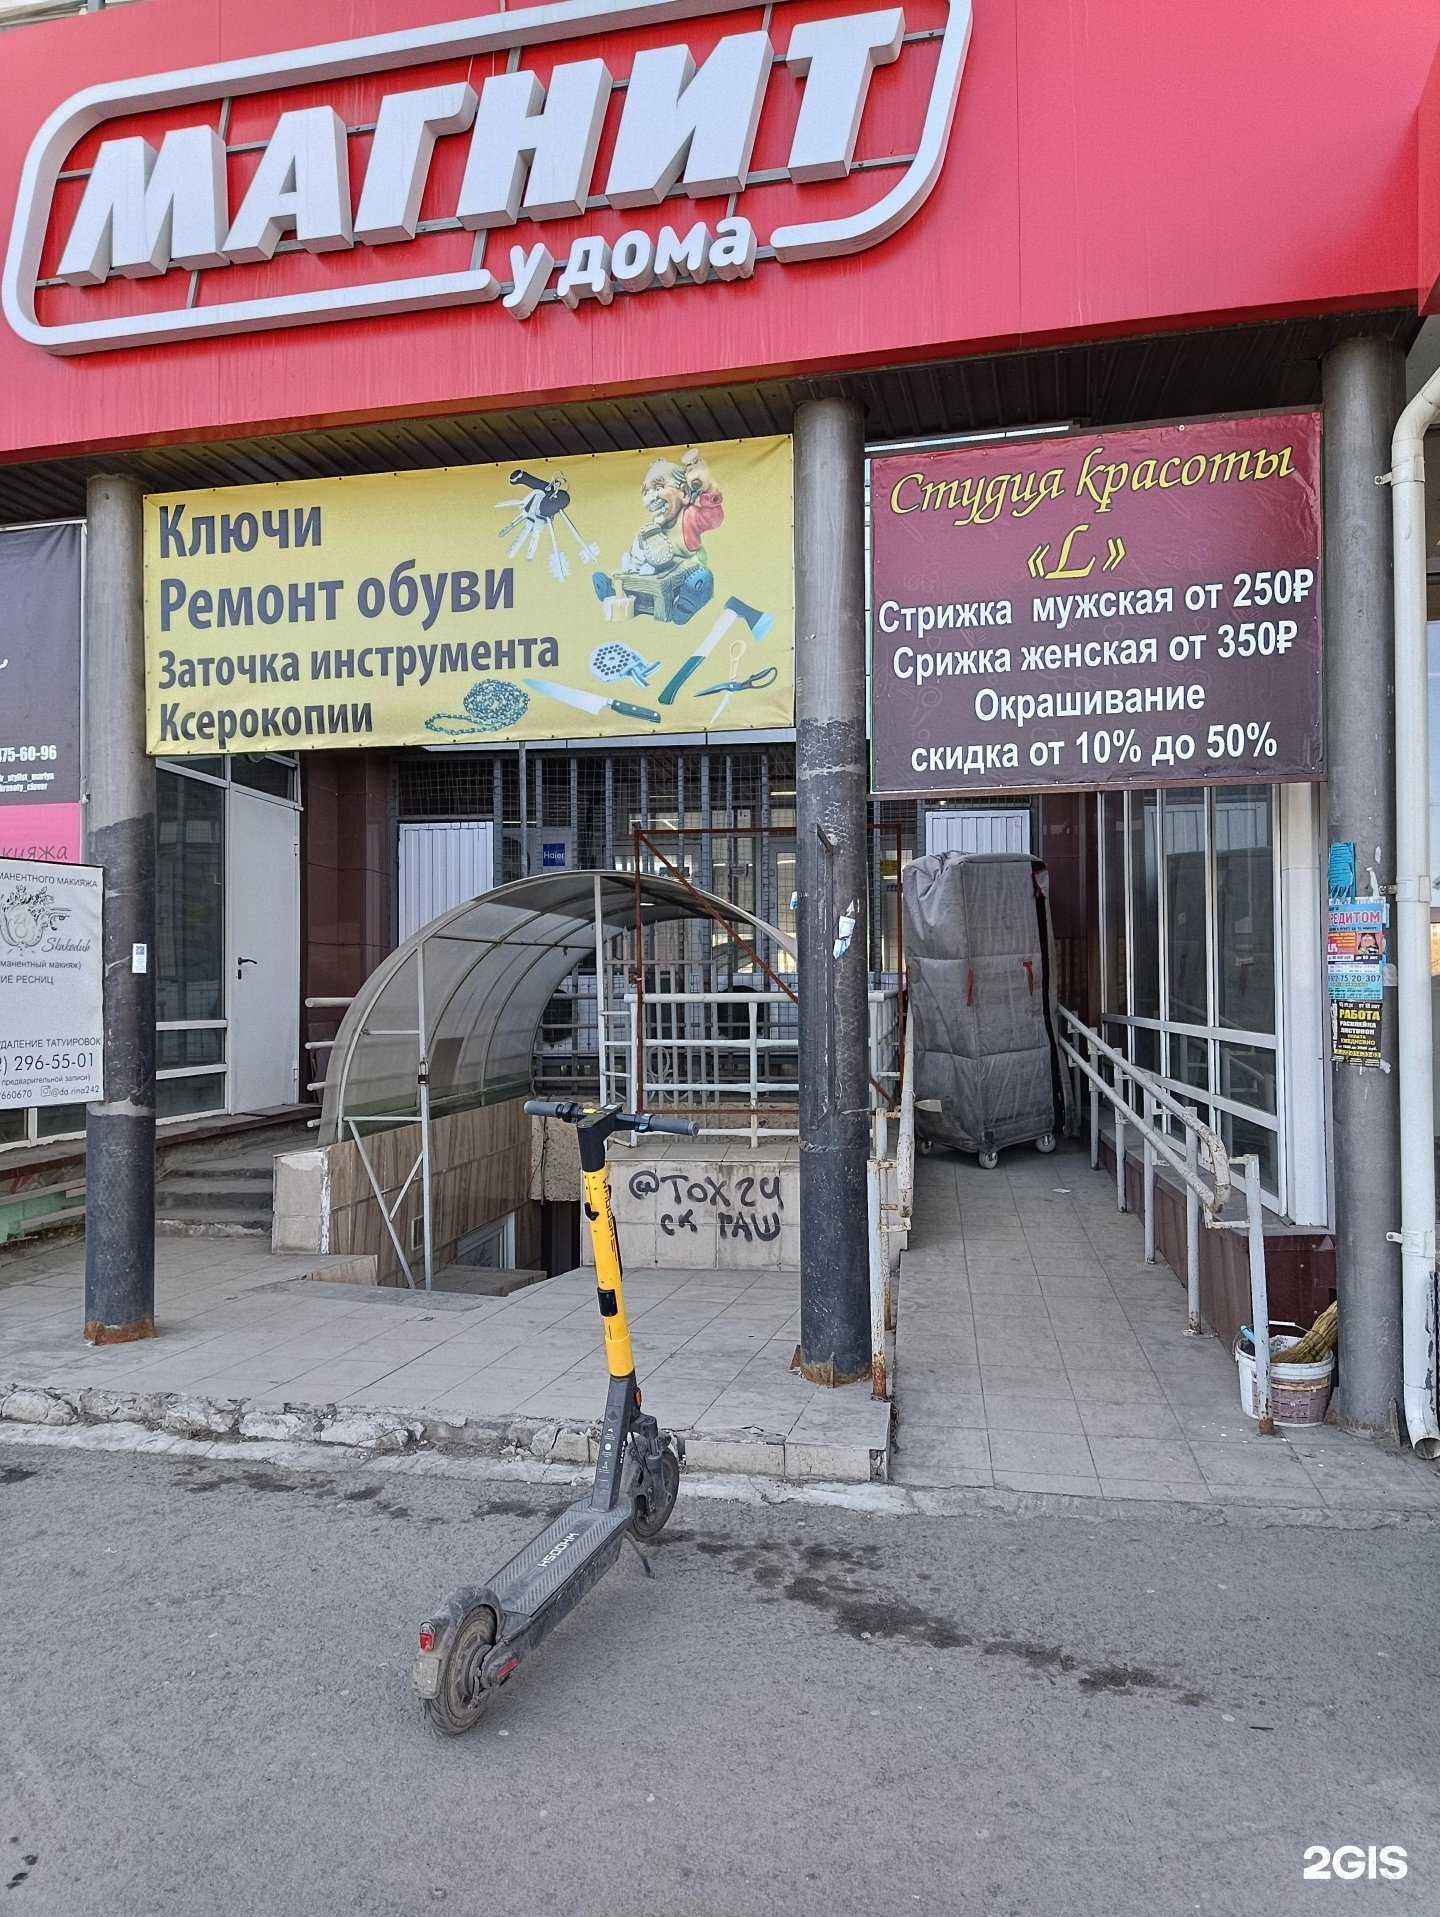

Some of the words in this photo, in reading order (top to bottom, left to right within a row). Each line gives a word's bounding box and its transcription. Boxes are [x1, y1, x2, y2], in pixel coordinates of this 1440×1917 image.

[56, 6, 906, 285] МАГНИТ
[503, 242, 553, 319] у
[557, 216, 757, 309] дома
[890, 469, 1066, 526] Студия
[1075, 445, 1296, 513] красоты
[159, 503, 322, 559] Ключи
[160, 576, 344, 633] Ремонт
[357, 558, 515, 631] обуви
[878, 597, 1012, 638] Стрижка
[1033, 586, 1173, 630] мужская
[1185, 583, 1223, 611] от
[159, 648, 300, 690] Заточка
[311, 635, 559, 687] инструмента
[893, 644, 1011, 685] Срижка
[1021, 636, 1158, 671] женская
[1168, 633, 1207, 662] от
[159, 697, 373, 750] Ксерокопии
[974, 683, 1206, 727] Окрашивание
[910, 742, 1019, 776] скидка
[1028, 739, 1065, 767] от
[1075, 728, 1142, 764] 10%
[1151, 734, 1196, 766] до
[1206, 721, 1278, 758] 50%
[16, 975, 55, 985] РЕСНИЦ
[1339, 1008, 1381, 1021] РАБОТА
[14, 1052, 93, 1071] 296-55-01
[46, 1037, 101, 1048] ТАТУИРОВОК
